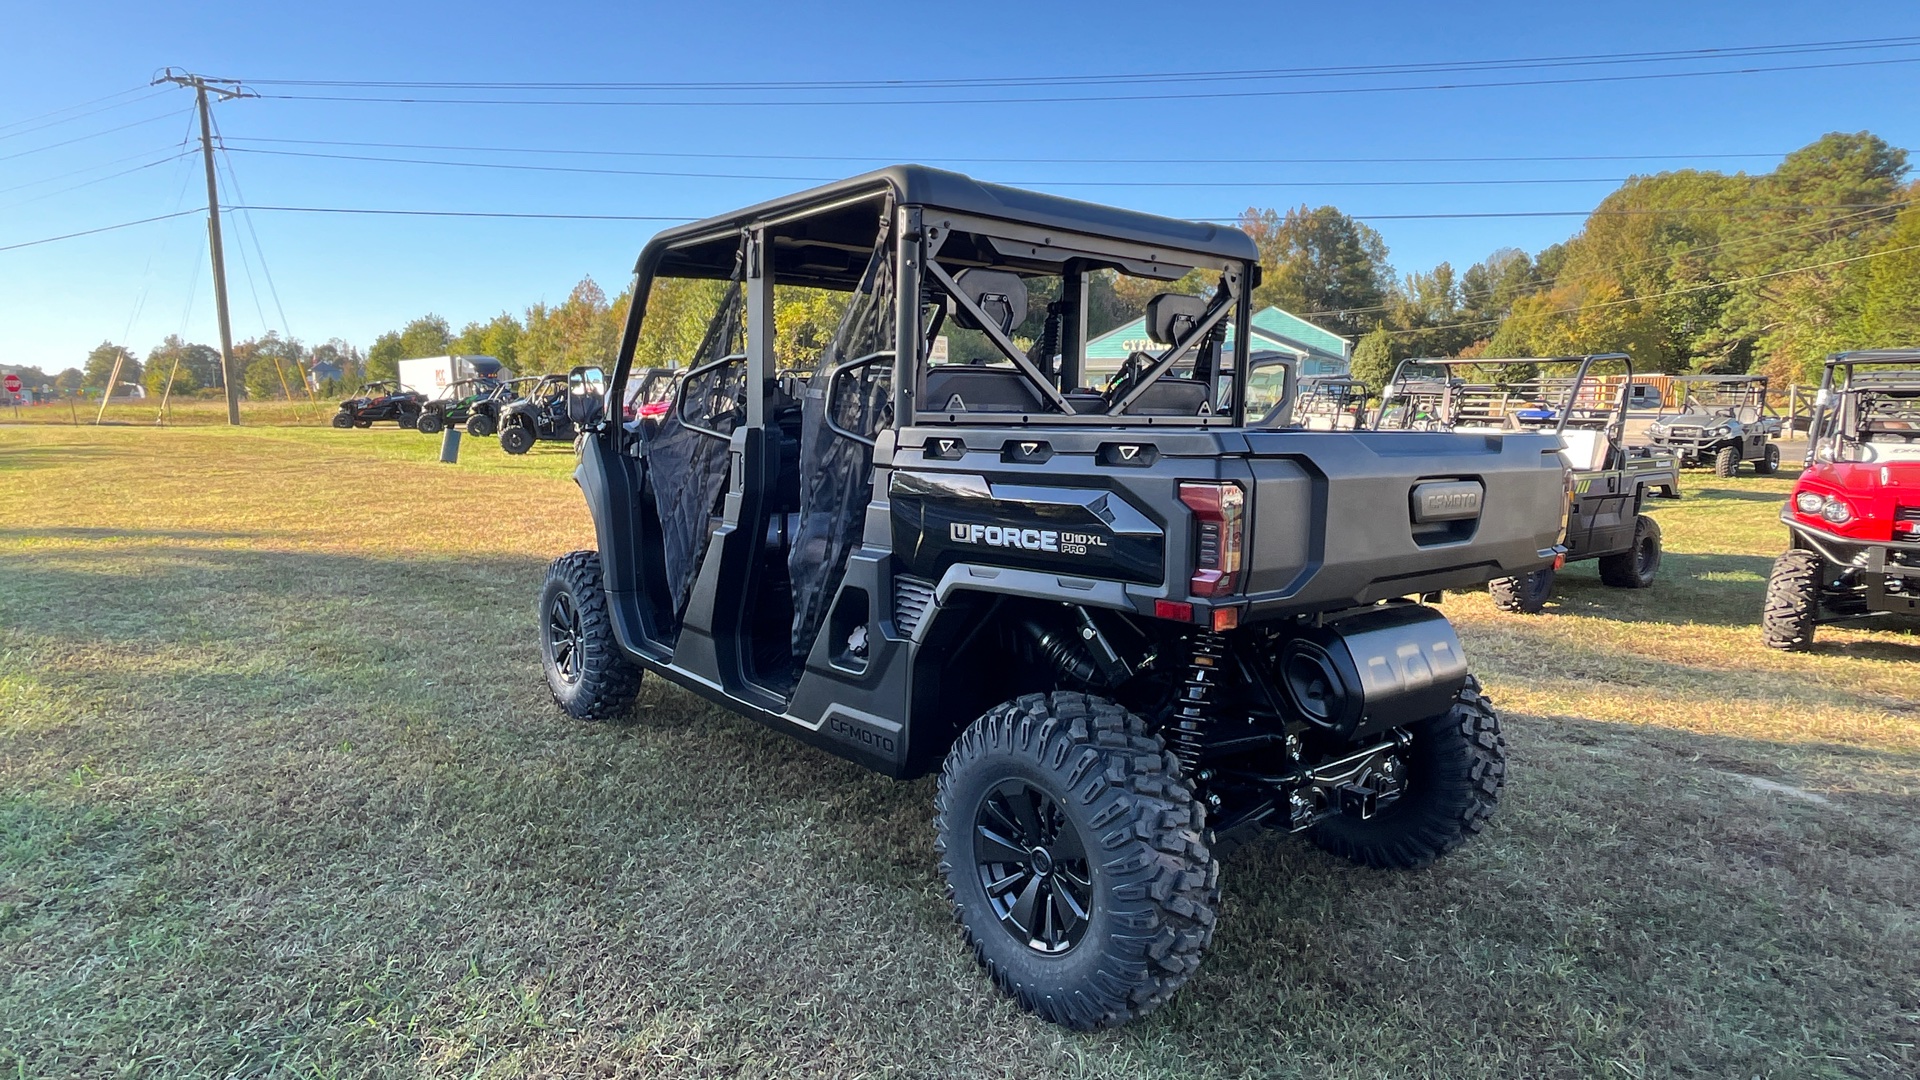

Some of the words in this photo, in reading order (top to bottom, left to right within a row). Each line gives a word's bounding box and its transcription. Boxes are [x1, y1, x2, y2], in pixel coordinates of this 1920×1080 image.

[4, 380, 21, 388] STOP
[1428, 493, 1477, 508] CFMOTO
[1061, 543, 1087, 555] PRO
[830, 717, 895, 753] CFMOTO
